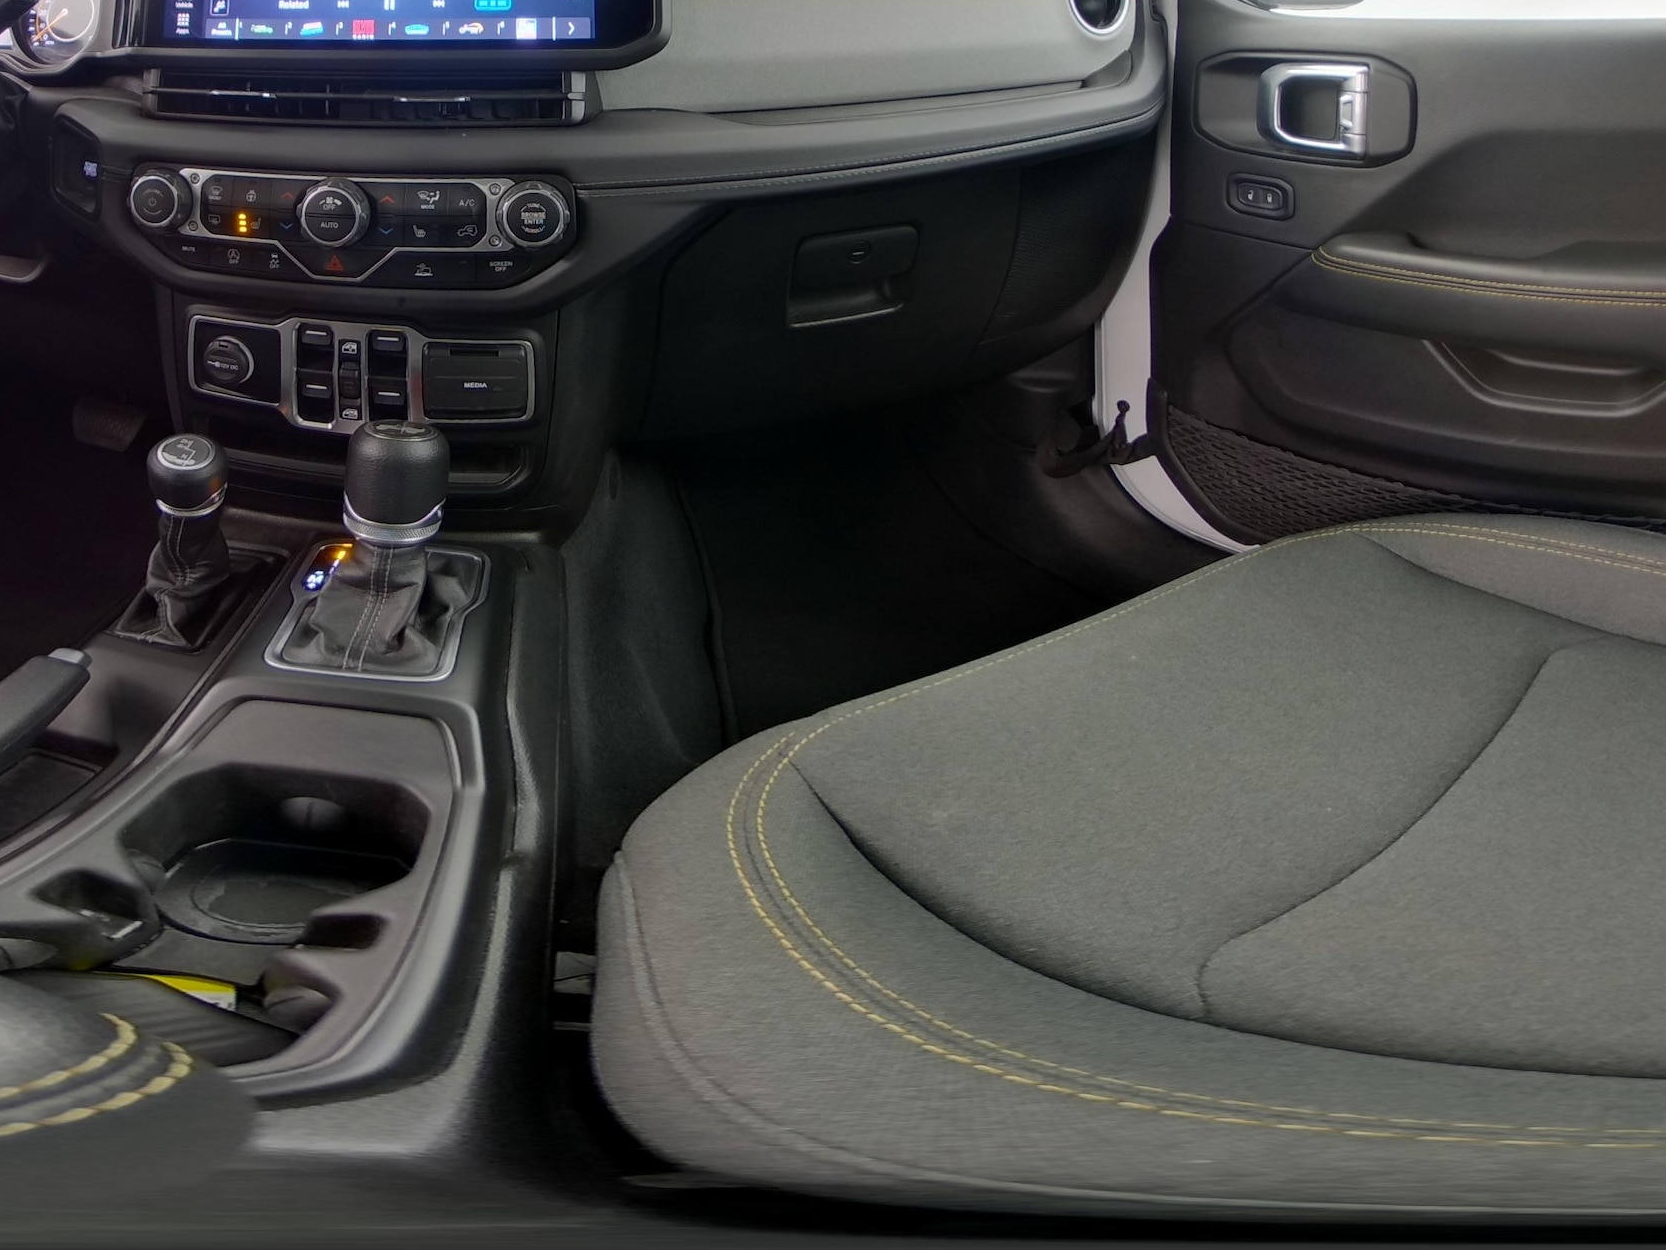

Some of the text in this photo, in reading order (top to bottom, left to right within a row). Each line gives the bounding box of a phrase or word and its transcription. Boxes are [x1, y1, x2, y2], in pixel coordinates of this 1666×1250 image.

[278, 0, 310, 10] Related
[458, 199, 476, 207] A/C
[520, 211, 546, 220] BROWSE
[320, 221, 339, 229] AUTO
